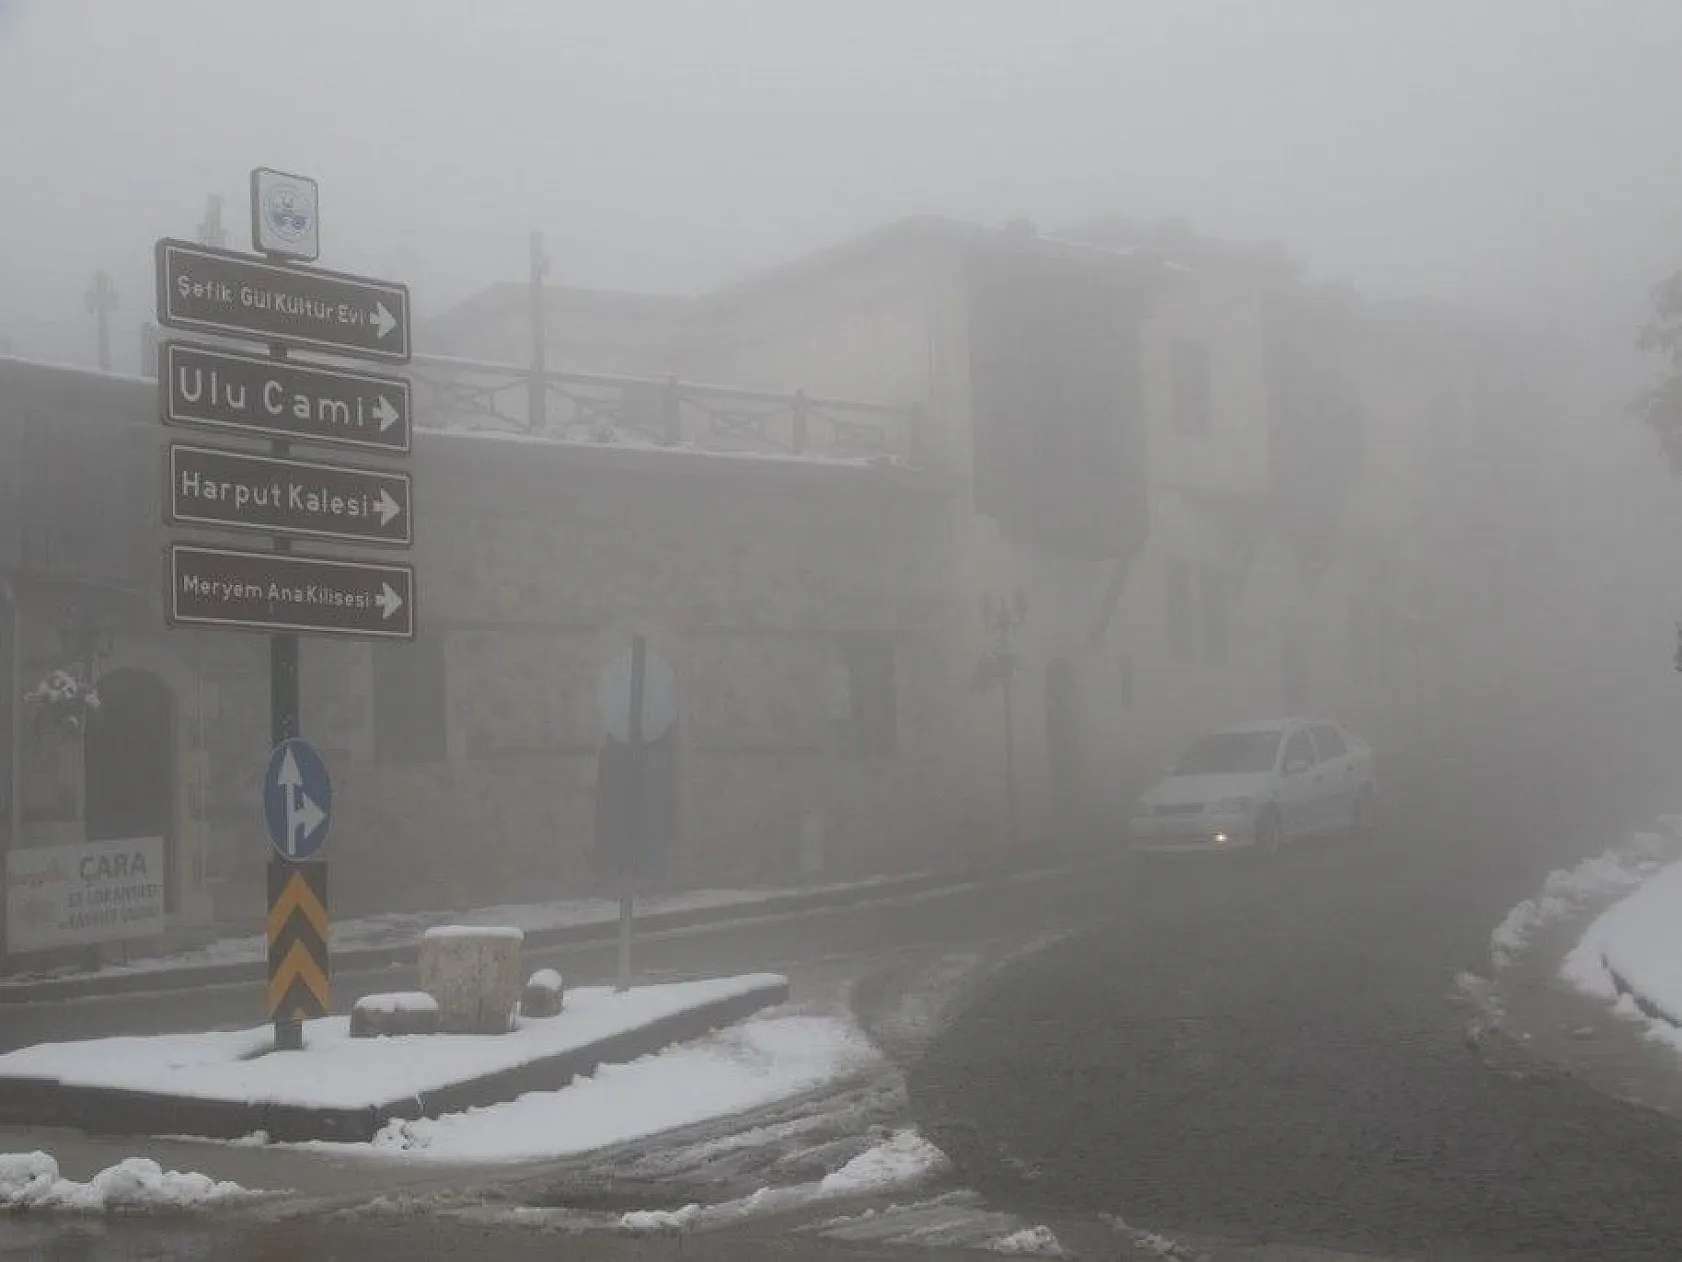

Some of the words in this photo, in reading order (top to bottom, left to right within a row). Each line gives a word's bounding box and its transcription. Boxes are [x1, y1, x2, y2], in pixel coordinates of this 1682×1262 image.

[177, 275, 232, 302] Şefik
[179, 366, 246, 409] Ulu
[264, 379, 364, 427] Cami
[182, 470, 281, 508] Harput
[288, 482, 367, 516] Kalesi
[183, 574, 262, 600] Meryem
[268, 582, 301, 602] Ana
[306, 584, 369, 609] Kilisesi
